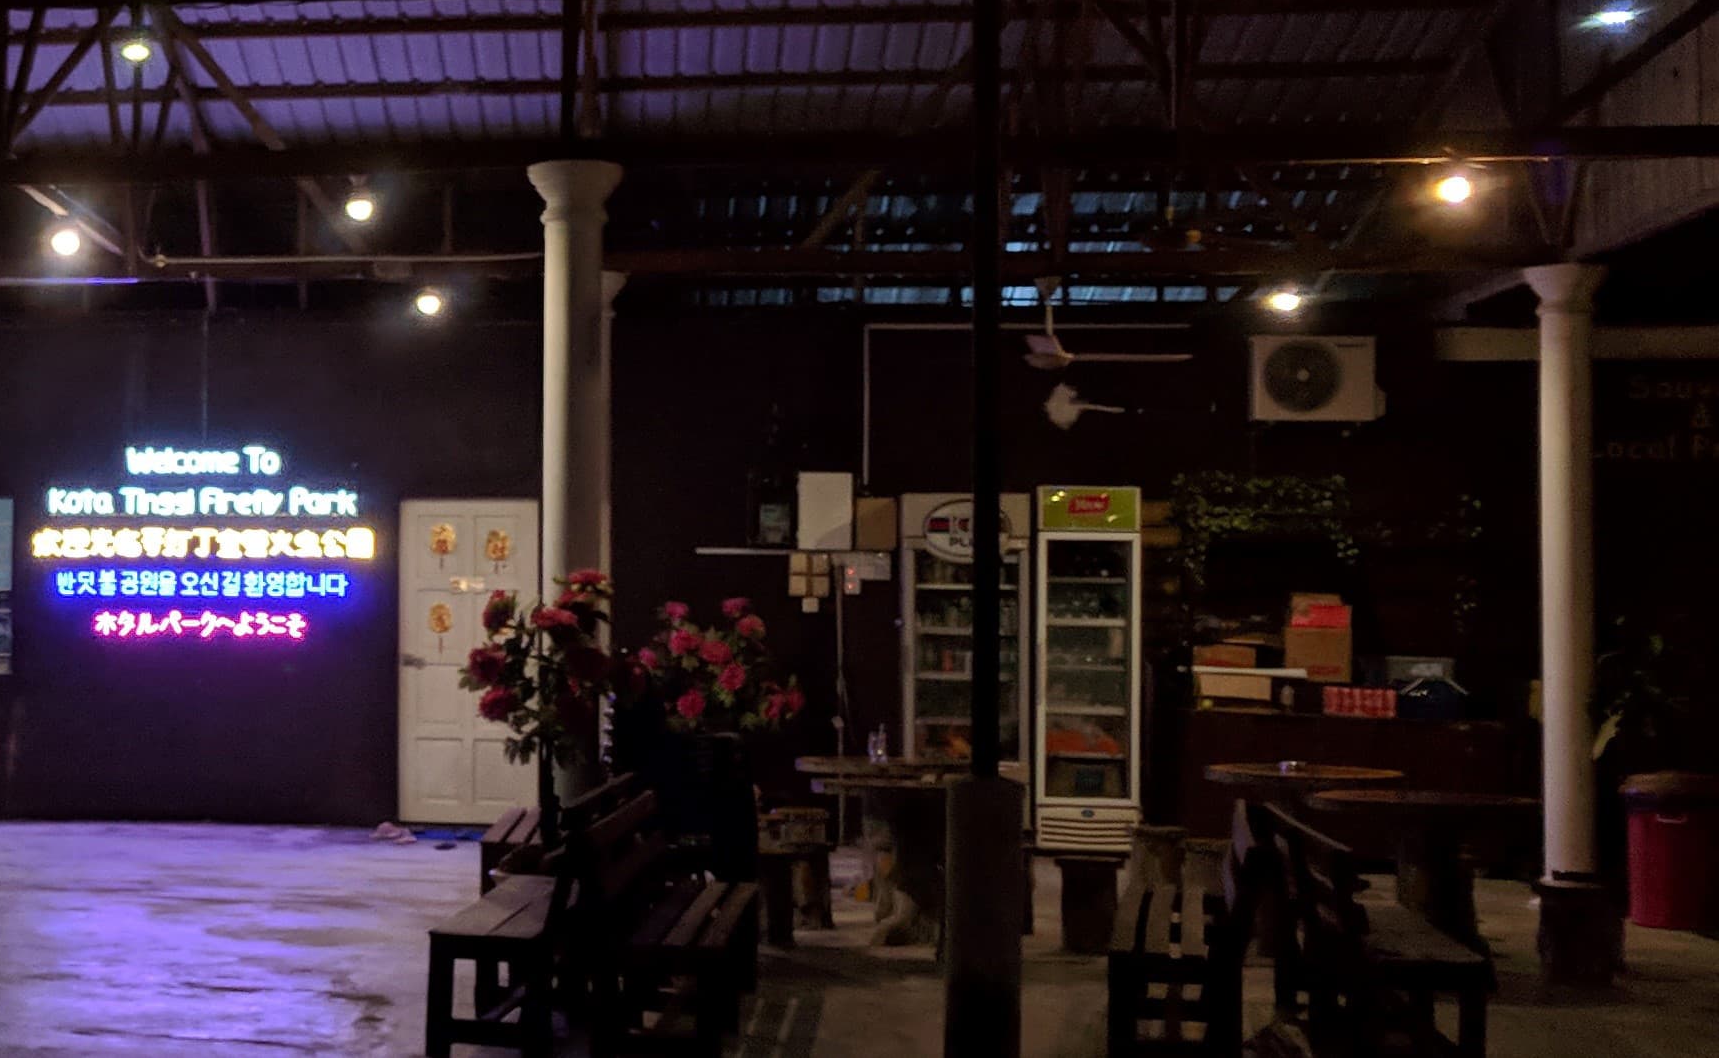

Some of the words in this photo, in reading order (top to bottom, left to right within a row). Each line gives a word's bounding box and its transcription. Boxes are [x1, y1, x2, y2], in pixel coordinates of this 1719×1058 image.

[126, 447, 239, 474] Welcome
[243, 447, 280, 474] To
[48, 488, 114, 515] Kota
[119, 487, 195, 516] Tinggi
[199, 487, 283, 516] Firefly
[288, 487, 357, 516] Park
[94, 610, 307, 640] ホタルパークへようこそ
